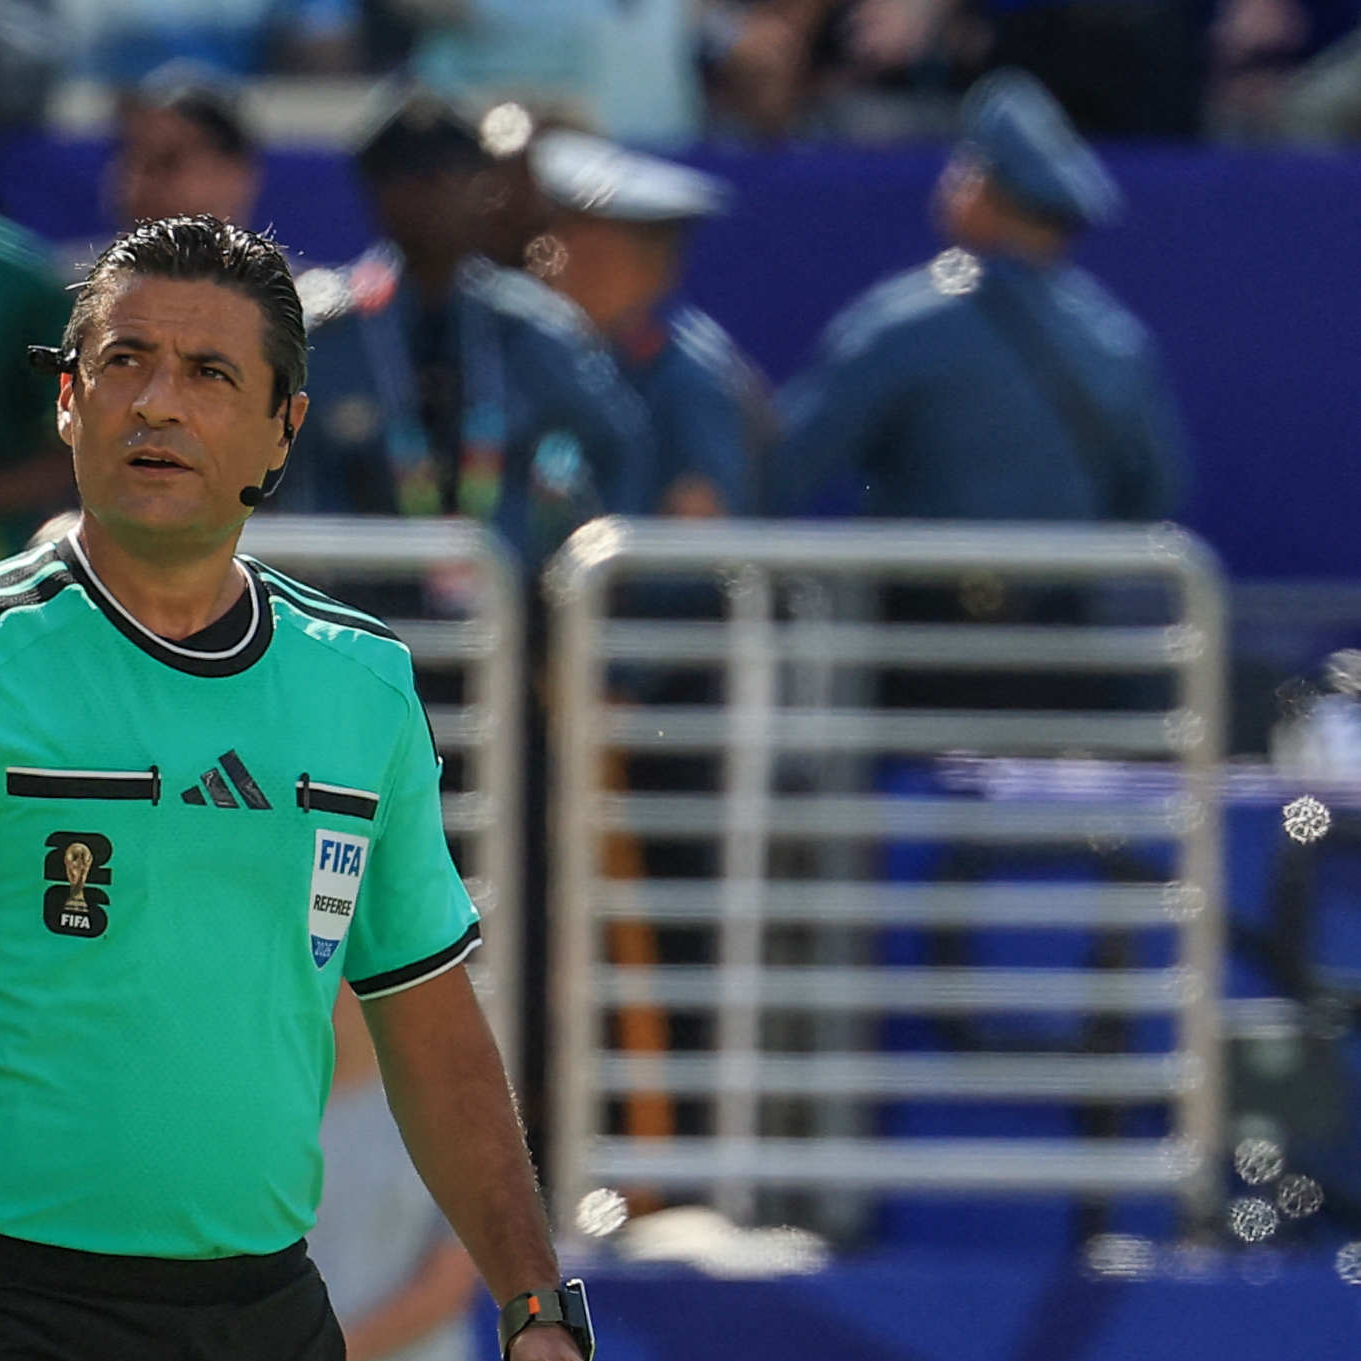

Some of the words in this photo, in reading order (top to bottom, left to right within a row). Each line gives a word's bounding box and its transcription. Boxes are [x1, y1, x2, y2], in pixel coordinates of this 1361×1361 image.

[319, 839, 361, 877] FIFA
[313, 894, 352, 917] REFEREE
[60, 914, 90, 929] FIFA
